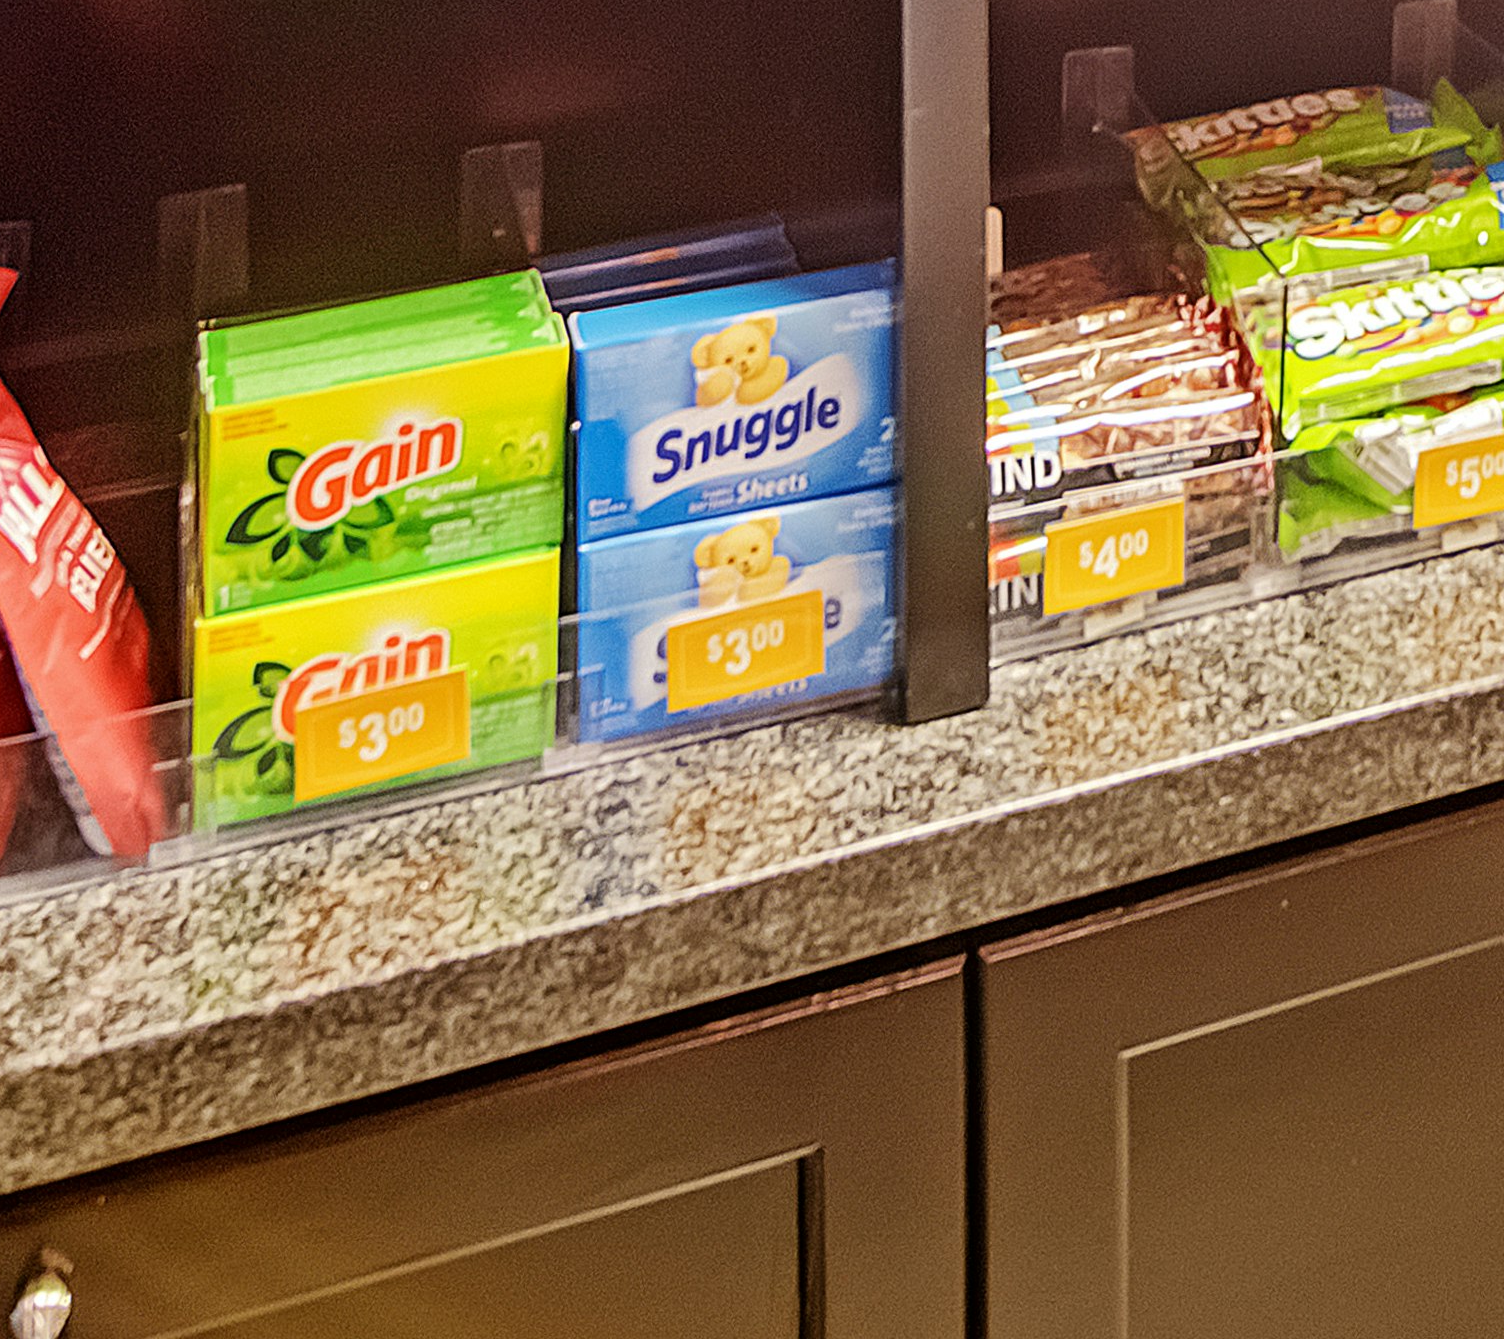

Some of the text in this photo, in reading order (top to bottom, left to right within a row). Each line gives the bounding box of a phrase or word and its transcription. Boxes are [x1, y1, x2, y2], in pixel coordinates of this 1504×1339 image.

[653, 386, 841, 485] Snuggle
[990, 448, 1064, 497] IND
[293, 420, 459, 526] Gain
[735, 472, 810, 505] Sheets
